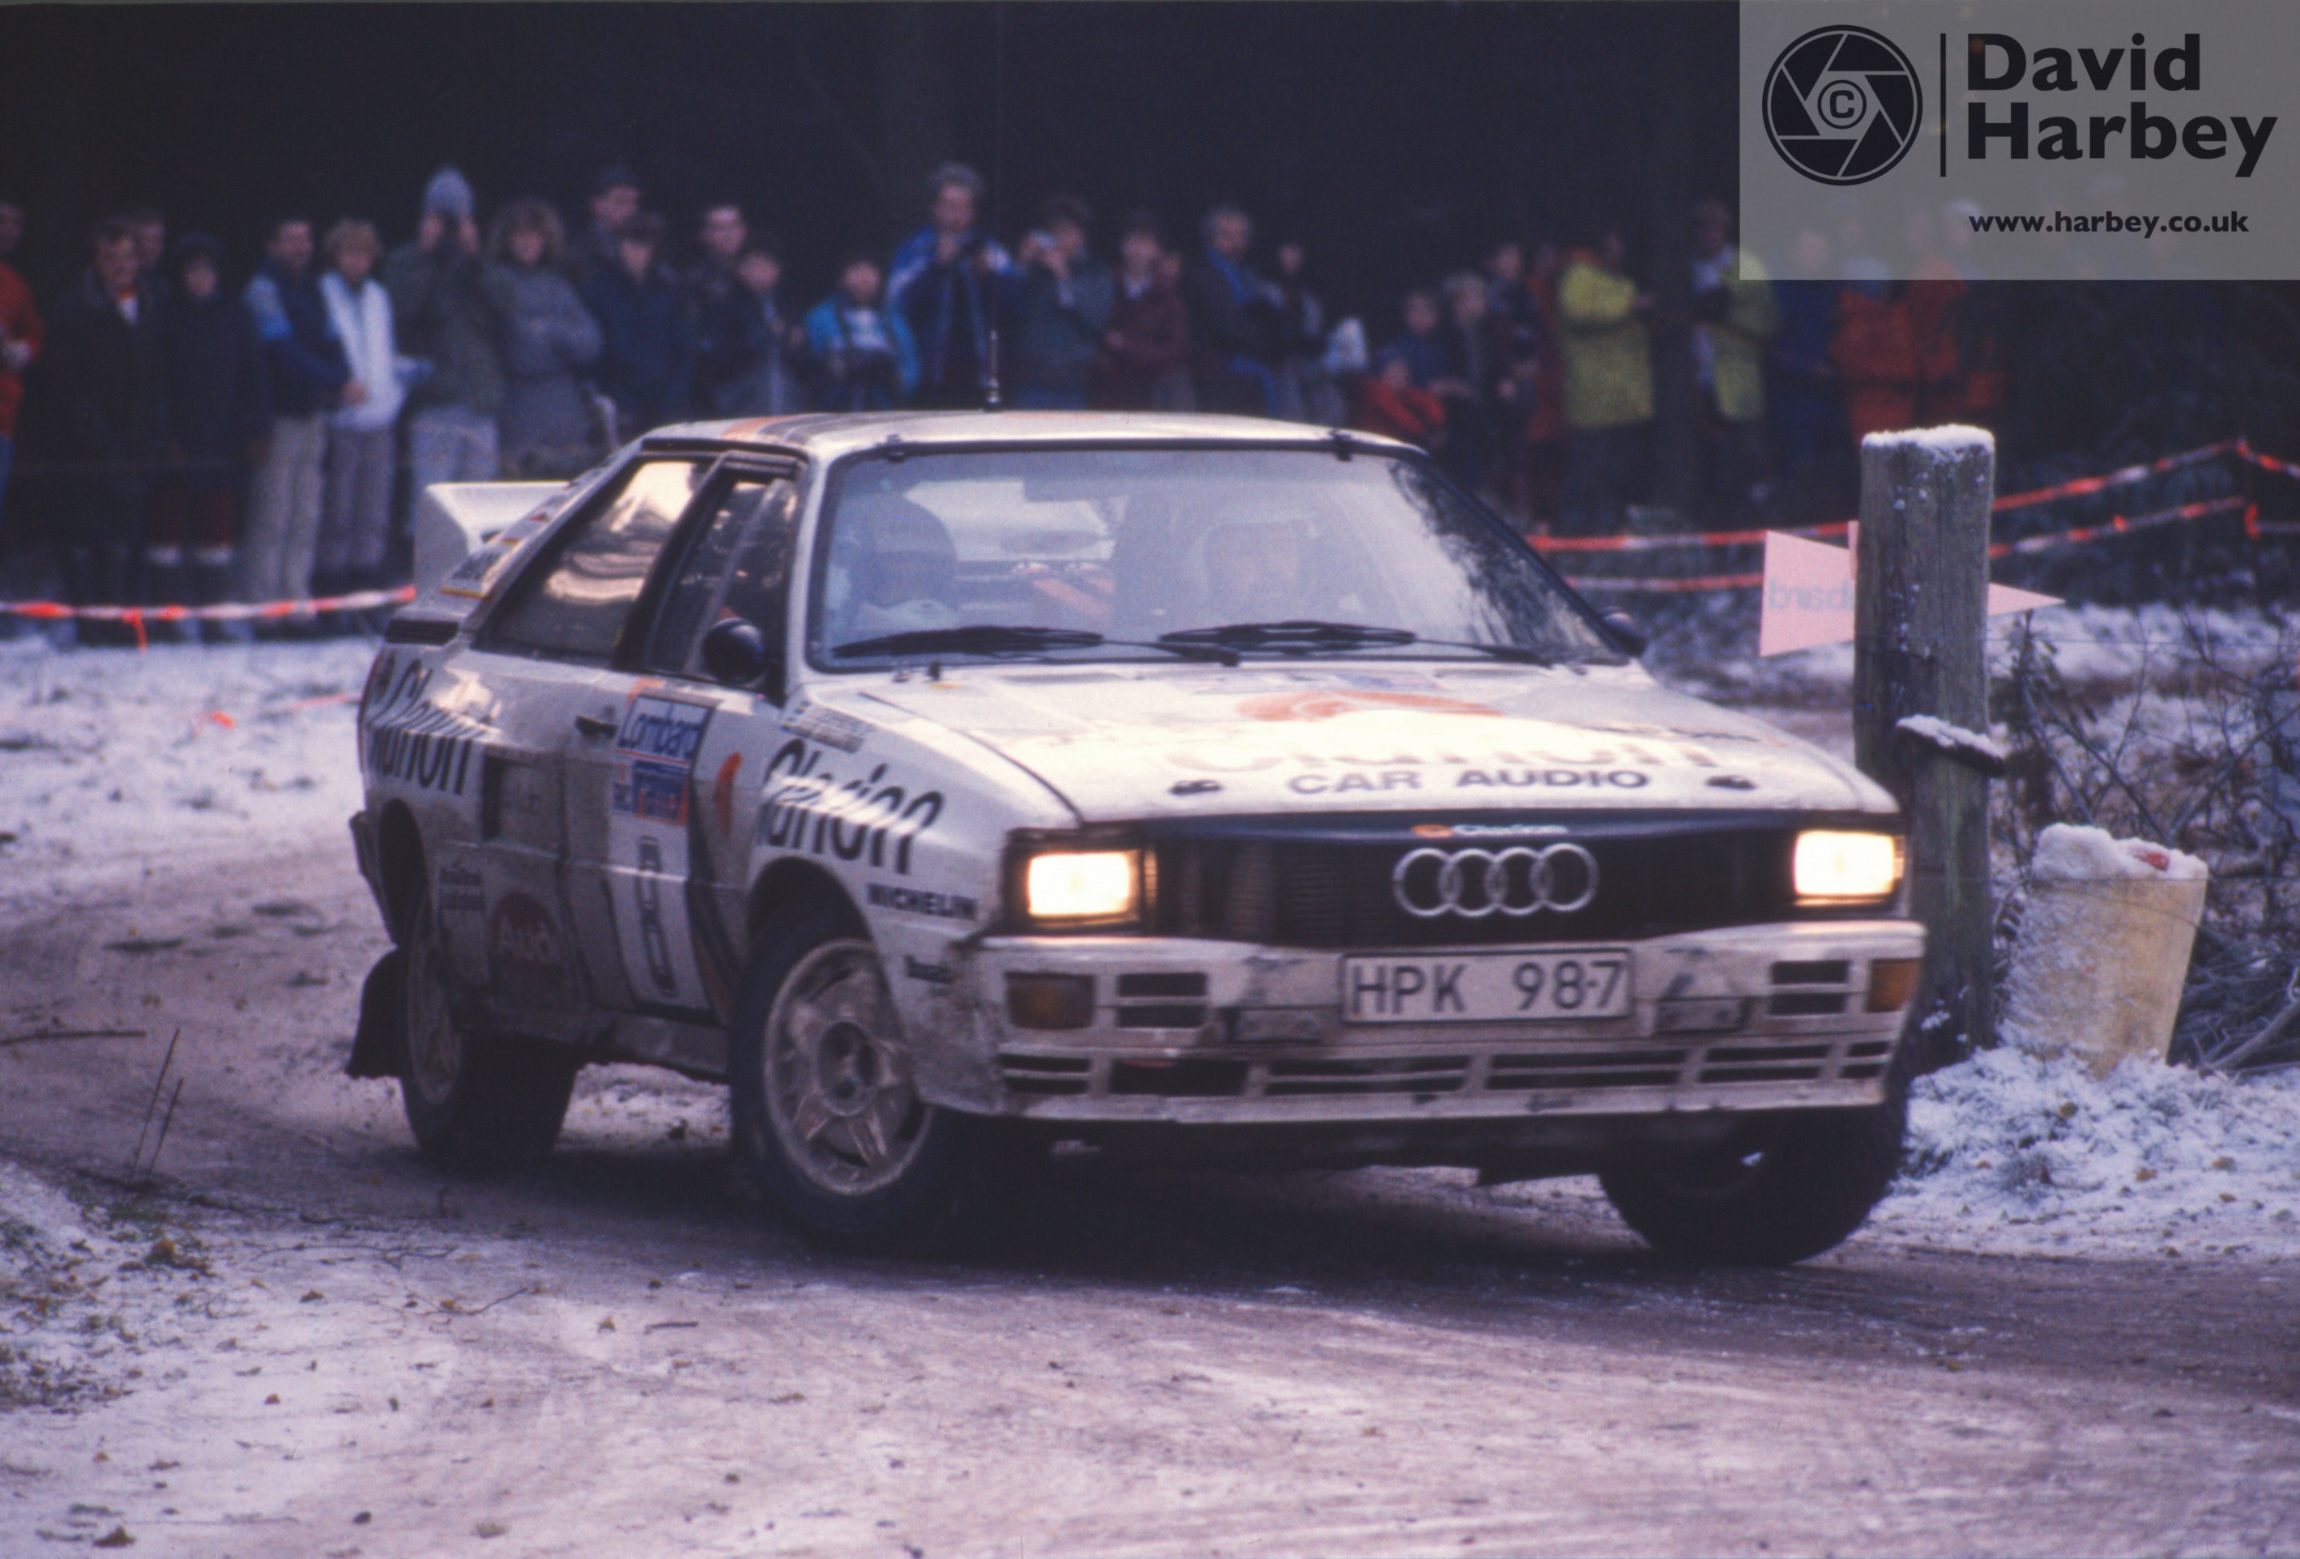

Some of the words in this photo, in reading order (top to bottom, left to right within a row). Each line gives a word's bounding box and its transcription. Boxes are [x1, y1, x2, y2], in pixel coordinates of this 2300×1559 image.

[764, 738, 944, 876] Clarion
[1287, 770, 1422, 795] CAR
[1455, 768, 1650, 790] AUDIO
[1352, 963, 1468, 1014] HPK
